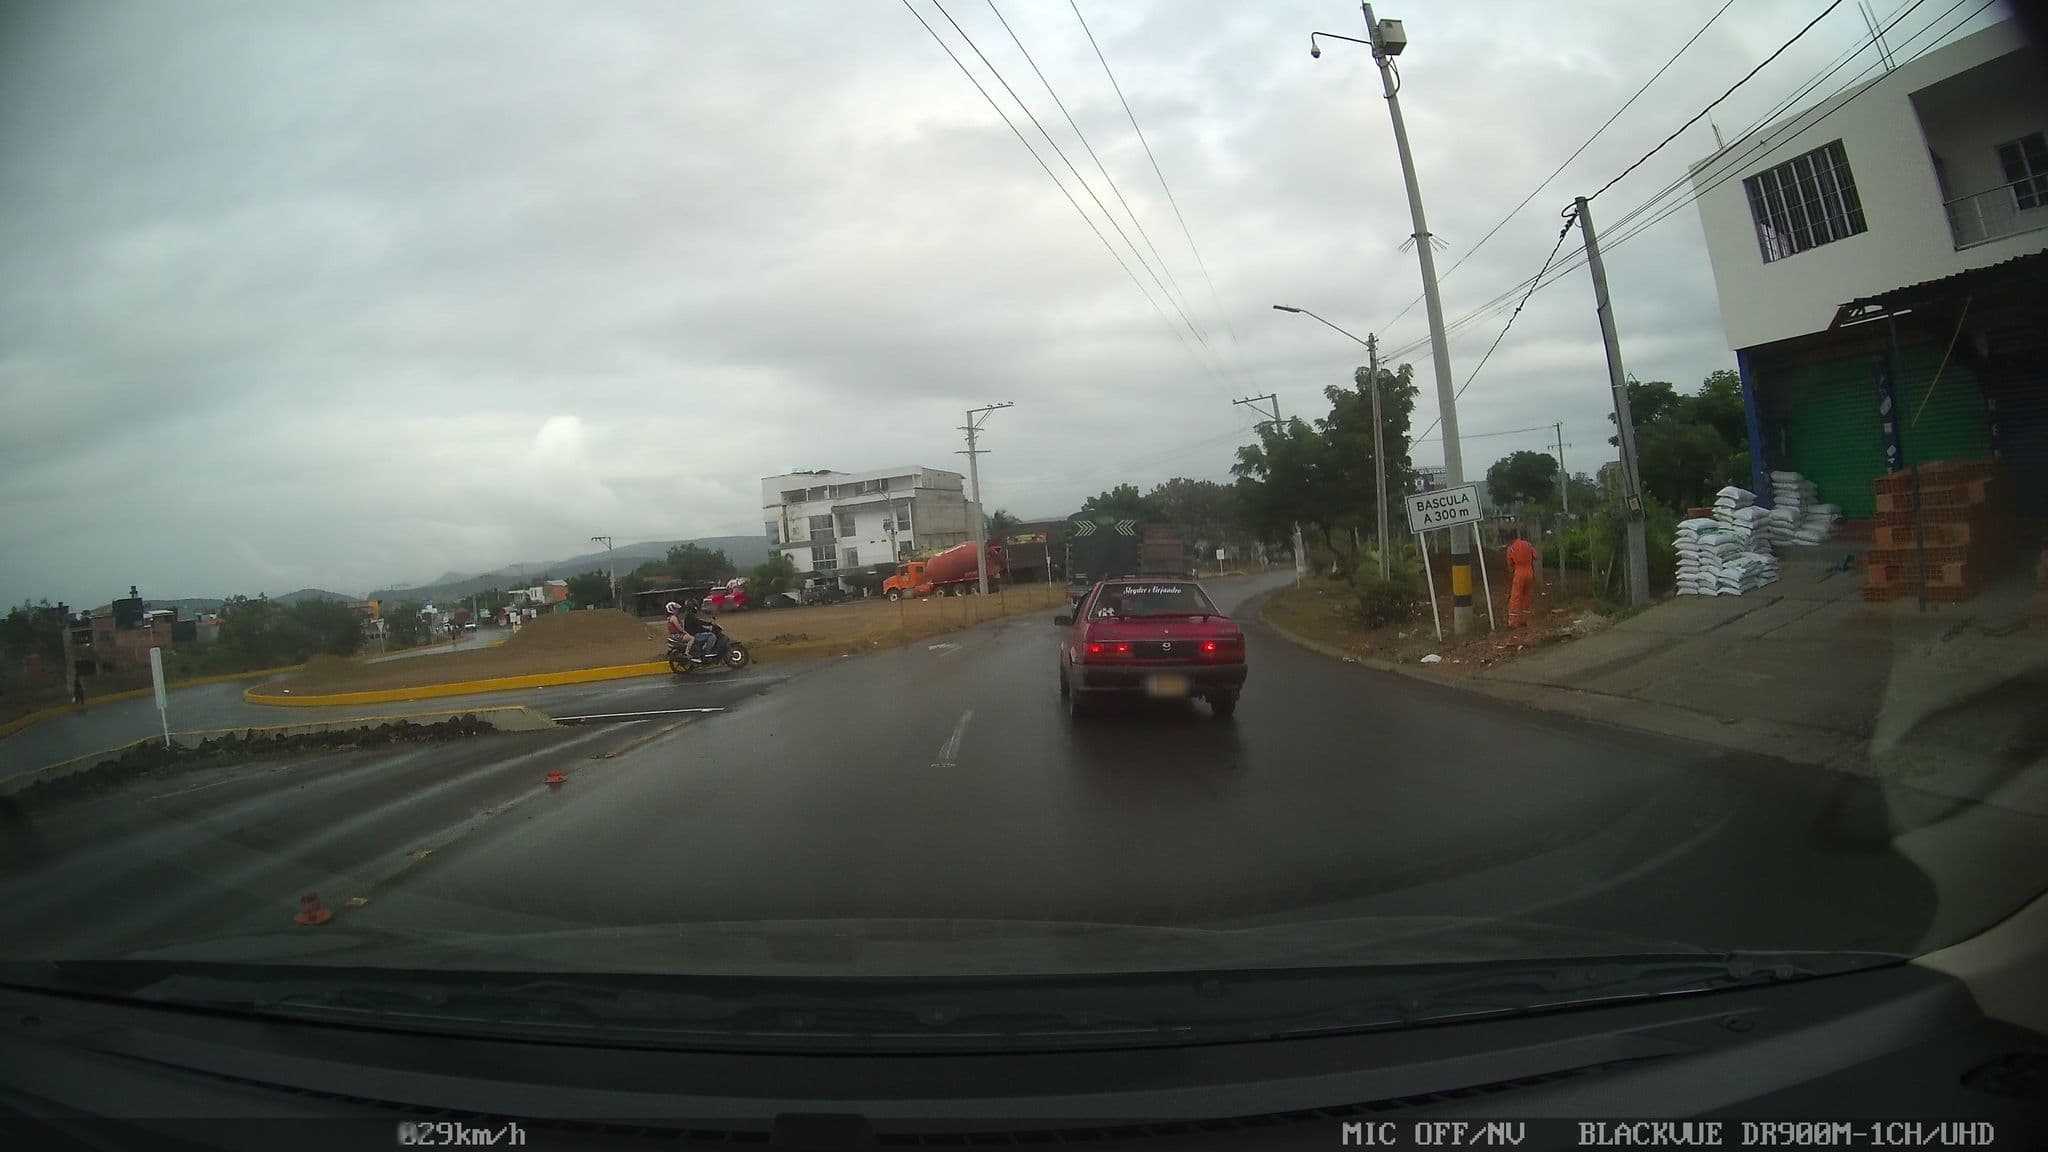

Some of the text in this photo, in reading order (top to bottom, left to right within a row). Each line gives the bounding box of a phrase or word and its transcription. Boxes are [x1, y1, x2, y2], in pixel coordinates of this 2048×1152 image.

[1417, 494, 1469, 512] BASCULA
[1424, 508, 1469, 524] A 300 m
